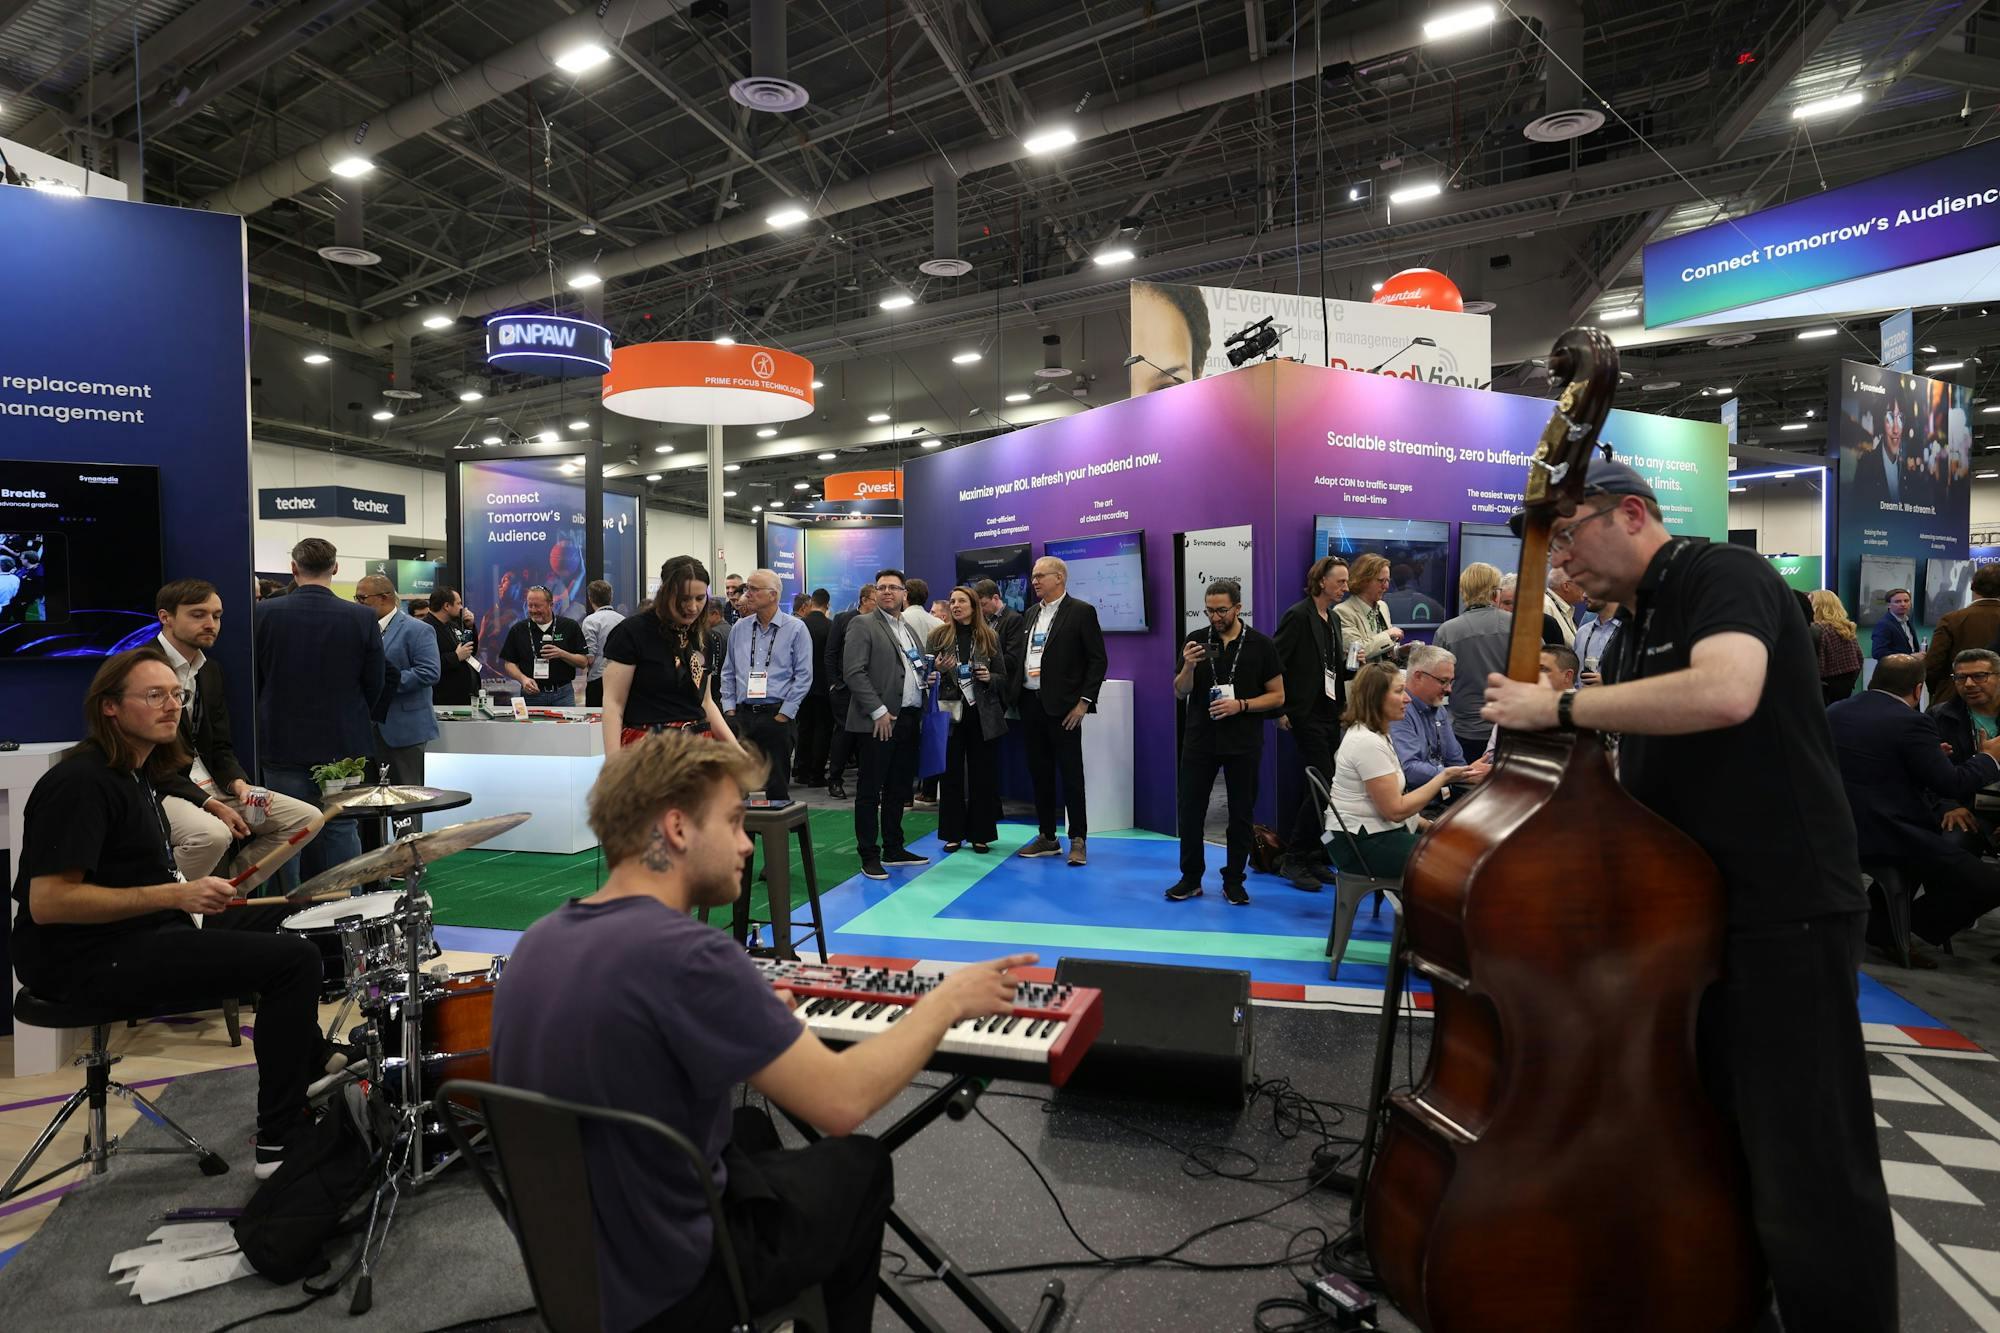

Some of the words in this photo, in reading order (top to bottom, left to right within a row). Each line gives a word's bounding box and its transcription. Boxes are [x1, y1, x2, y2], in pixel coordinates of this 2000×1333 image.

[1680, 249, 1760, 283] Connect
[1763, 216, 1889, 263] Tomorrow's
[515, 323, 577, 348] NPAW
[2, 376, 152, 398] replacement
[705, 376, 731, 385] PRIME
[733, 378, 760, 387] FOCUS
[761, 380, 805, 397] TECHNOLOGIES
[1860, 381, 1886, 395] Synamedia
[1327, 430, 1386, 451] Scalable
[1389, 441, 1457, 463] streaming,
[1459, 448, 1485, 462] zero
[1487, 447, 1533, 467] bufferin
[1635, 454, 1644, 467] to
[1646, 456, 1664, 472] any
[1666, 459, 1698, 474] screen,
[79, 475, 118, 483] Synamedia
[959, 484, 994, 502] Maximize
[995, 482, 1013, 499] your
[1014, 477, 1029, 492] ROI.
[1031, 470, 1064, 488] Refresh
[1065, 467, 1086, 486] your
[1088, 455, 1134, 477] headend
[1135, 451, 1162, 468] now.
[858, 482, 895, 493] Qvest
[1314, 475, 1338, 488] Adapt
[1339, 478, 1356, 487] CDN
[1356, 479, 1365, 488] to
[1366, 479, 1388, 490] traffic
[1388, 483, 1412, 493] surges
[1655, 477, 1683, 491] limits.
[1, 488, 46, 499] Breaks
[486, 491, 540, 505] Connect
[1344, 492, 1351, 502] in
[1352, 494, 1388, 504] real-time
[1468, 488, 1479, 498] The
[1480, 490, 1503, 500] easiest
[1504, 492, 1517, 502] way
[1518, 492, 1524, 501] to
[275, 497, 316, 510] techex
[352, 497, 389, 514] techex
[1094, 500, 1104, 508] The
[1104, 499, 1113, 508] art
[1472, 504, 1477, 512] a
[1478, 503, 1511, 514] multi-CDN
[1670, 504, 1694, 513] business
[1880, 500, 1898, 511] Dream
[1904, 504, 1912, 513] We
[1912, 504, 1931, 514] stream
[487, 510, 561, 524] Tomorrow's
[986, 514, 1016, 526] Cost-efficient
[1080, 515, 1086, 524] of
[1086, 513, 1101, 523] cloud
[1102, 510, 1128, 521] recording
[488, 530, 547, 543] Audience
[974, 528, 998, 539] processing
[1002, 524, 1029, 535] compression
